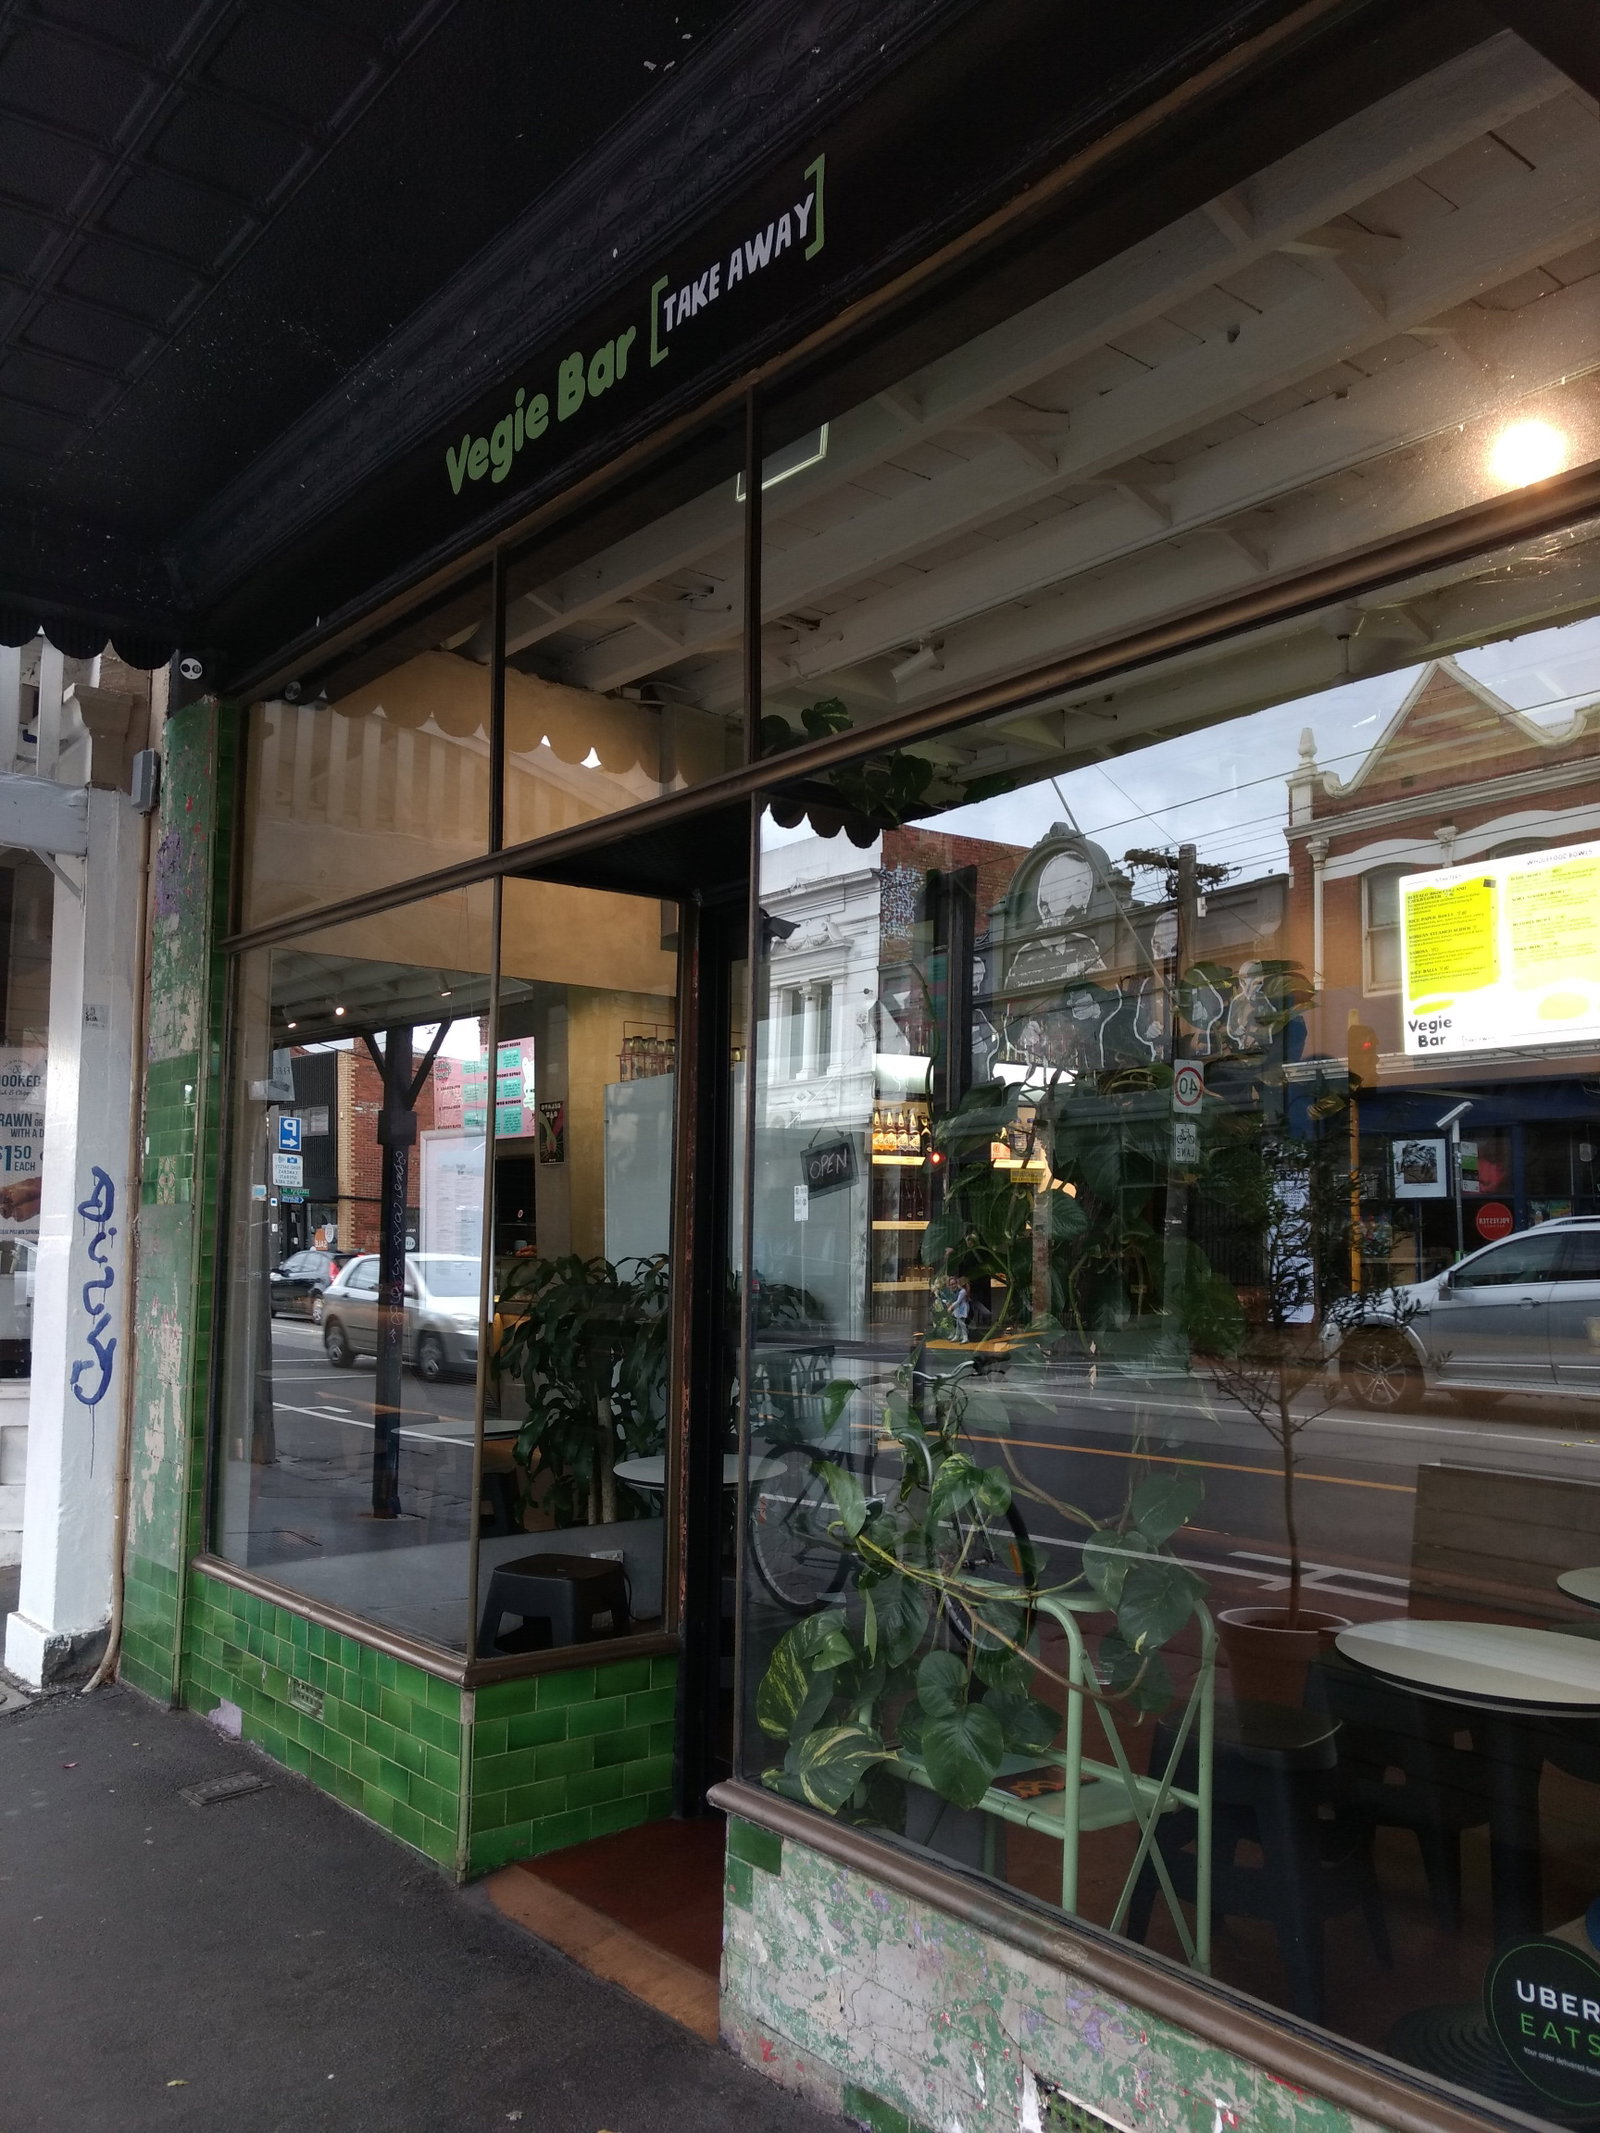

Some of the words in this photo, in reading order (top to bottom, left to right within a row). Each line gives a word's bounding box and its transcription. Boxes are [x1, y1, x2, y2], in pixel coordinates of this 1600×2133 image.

[663, 262, 721, 332] TAKE
[727, 193, 815, 291] AWAY
[446, 387, 549, 495] Vegie
[557, 325, 637, 422] Bar
[1408, 1016, 1453, 1033] Vegie
[1418, 1034, 1446, 1048] Bar
[0, 1074, 41, 1087] OOKED
[0, 1113, 32, 1127] RAWN
[10, 1128, 30, 1138] WITH
[32, 1128, 37, 1138] A
[14, 1161, 36, 1171] EACH
[810, 1147, 847, 1179] OPEN
[1516, 1979, 1600, 2025] UBER
[1520, 2013, 1600, 2057] EATS
